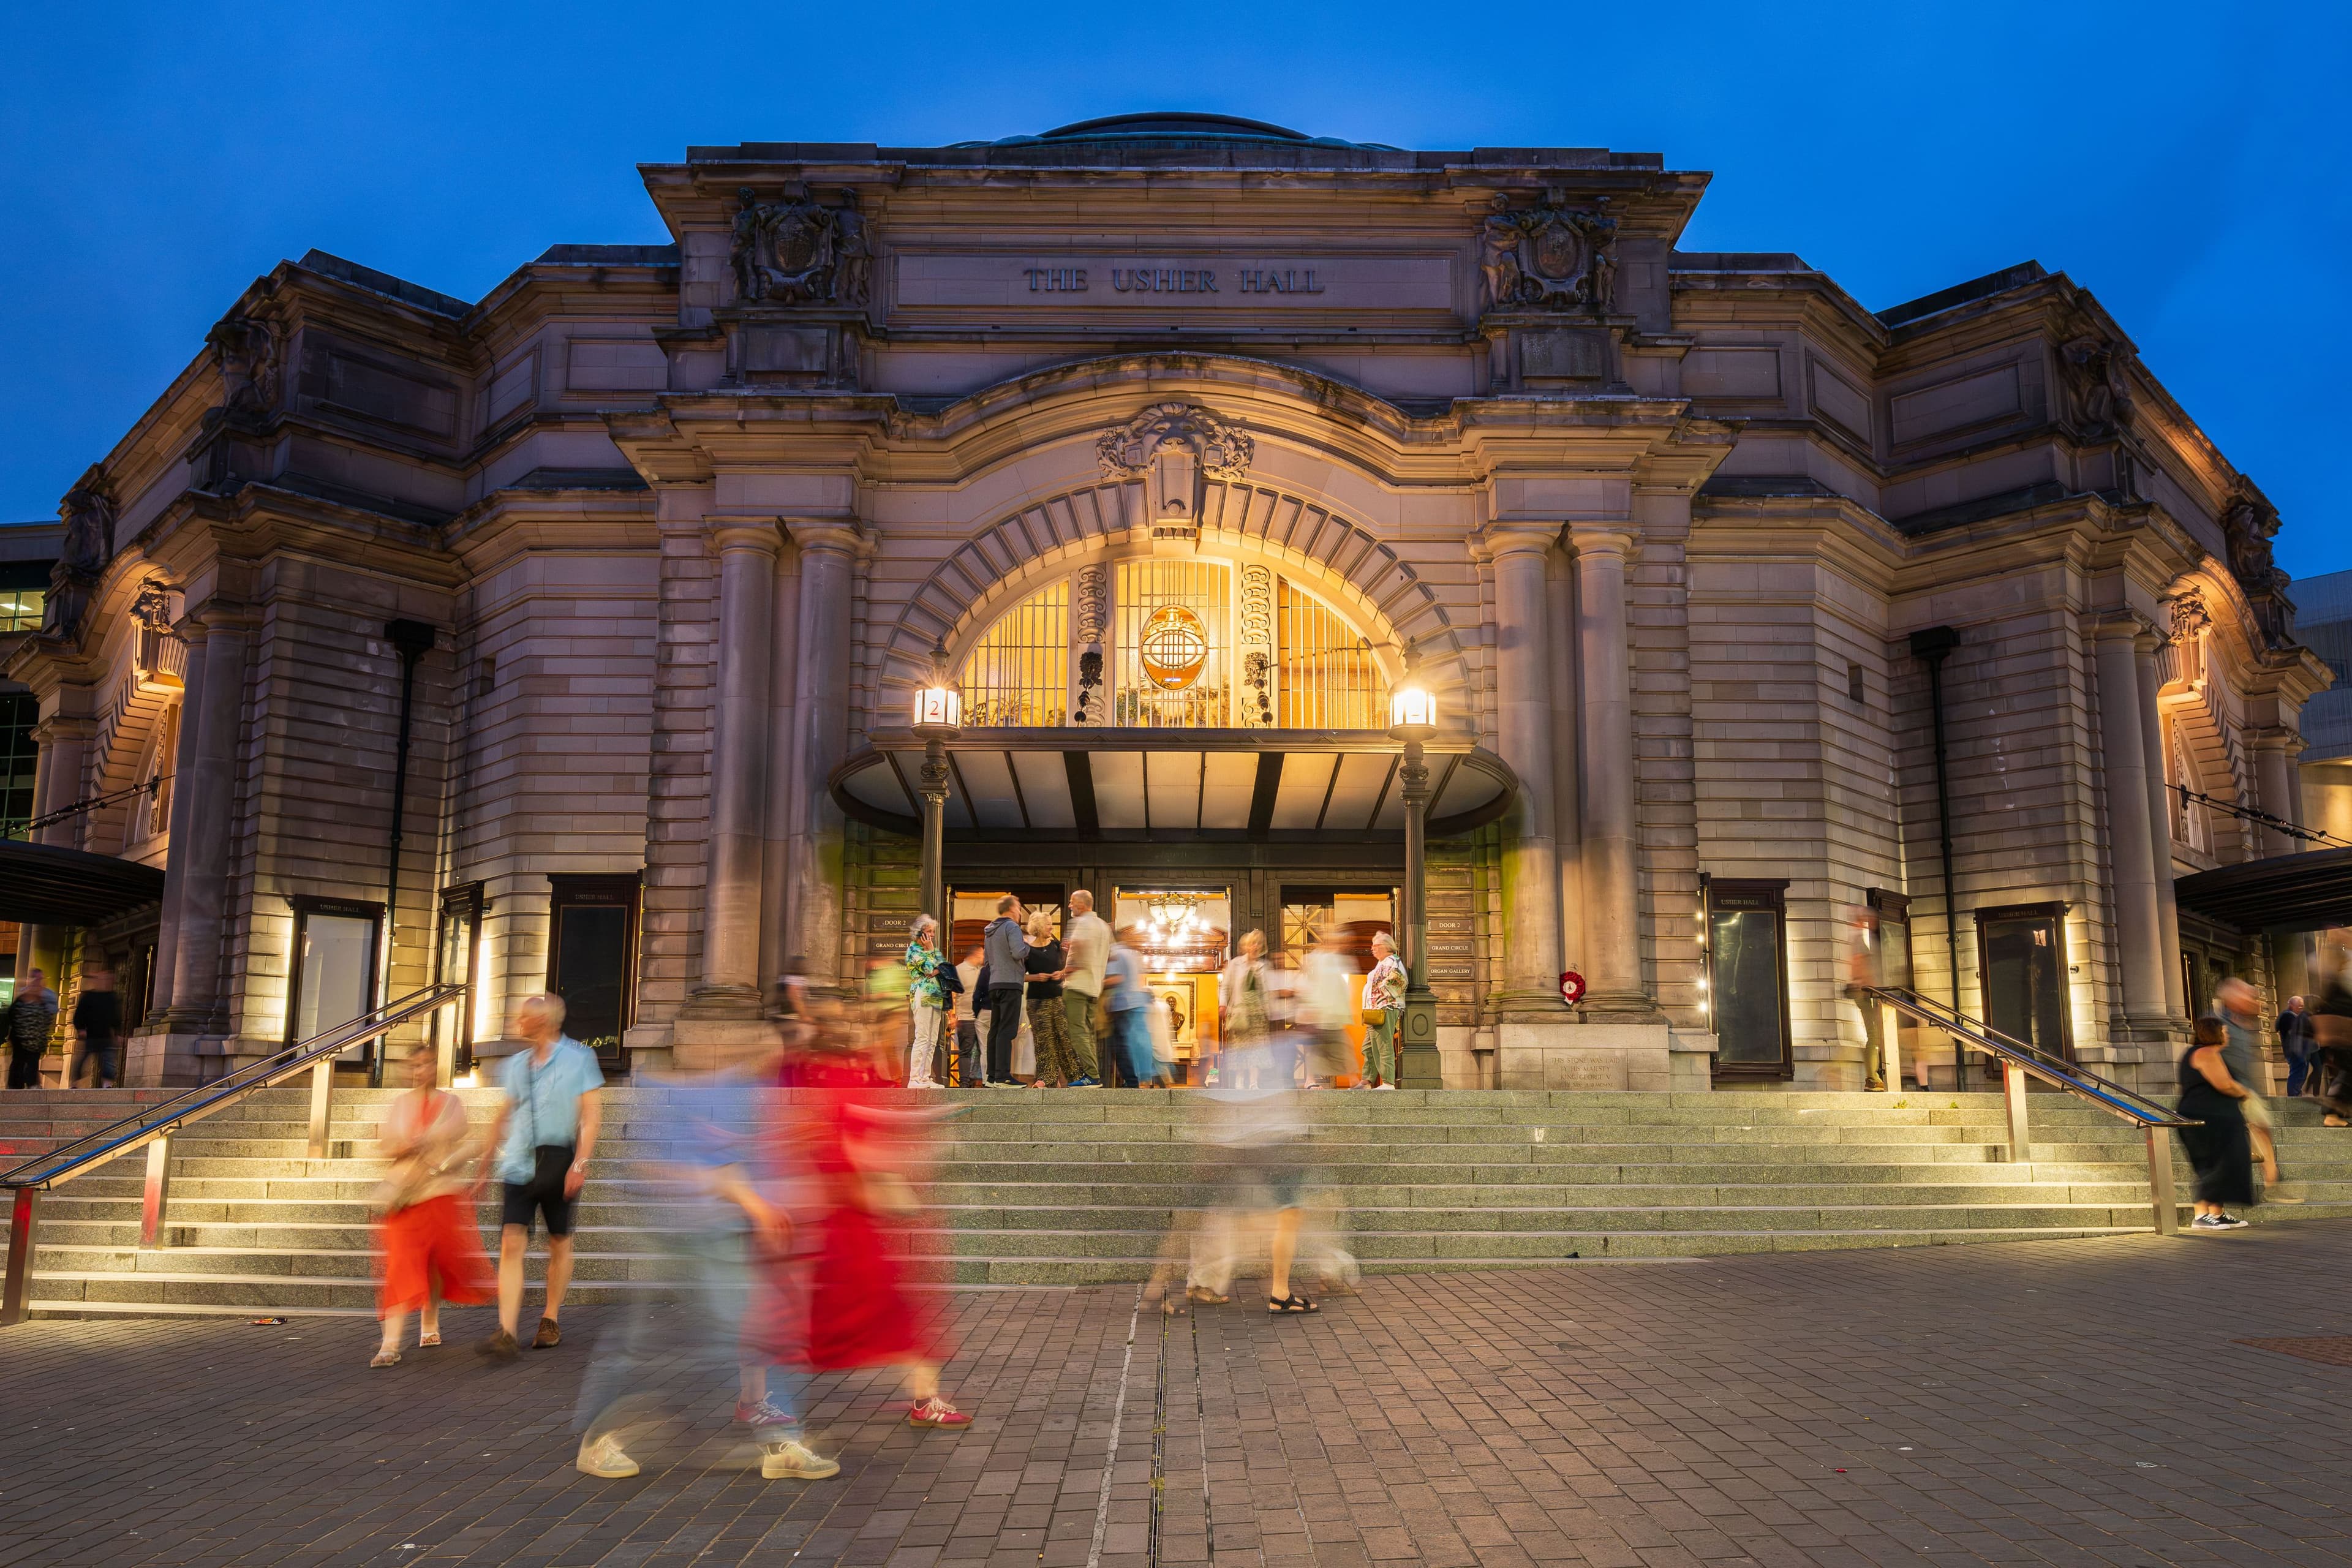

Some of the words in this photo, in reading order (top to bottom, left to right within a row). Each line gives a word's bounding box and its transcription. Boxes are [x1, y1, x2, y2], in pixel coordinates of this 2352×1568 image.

[1023, 269, 1088, 291] THE
[1112, 269, 1219, 292] USHER
[1239, 269, 1325, 293] HALL
[930, 700, 938, 715] 2
